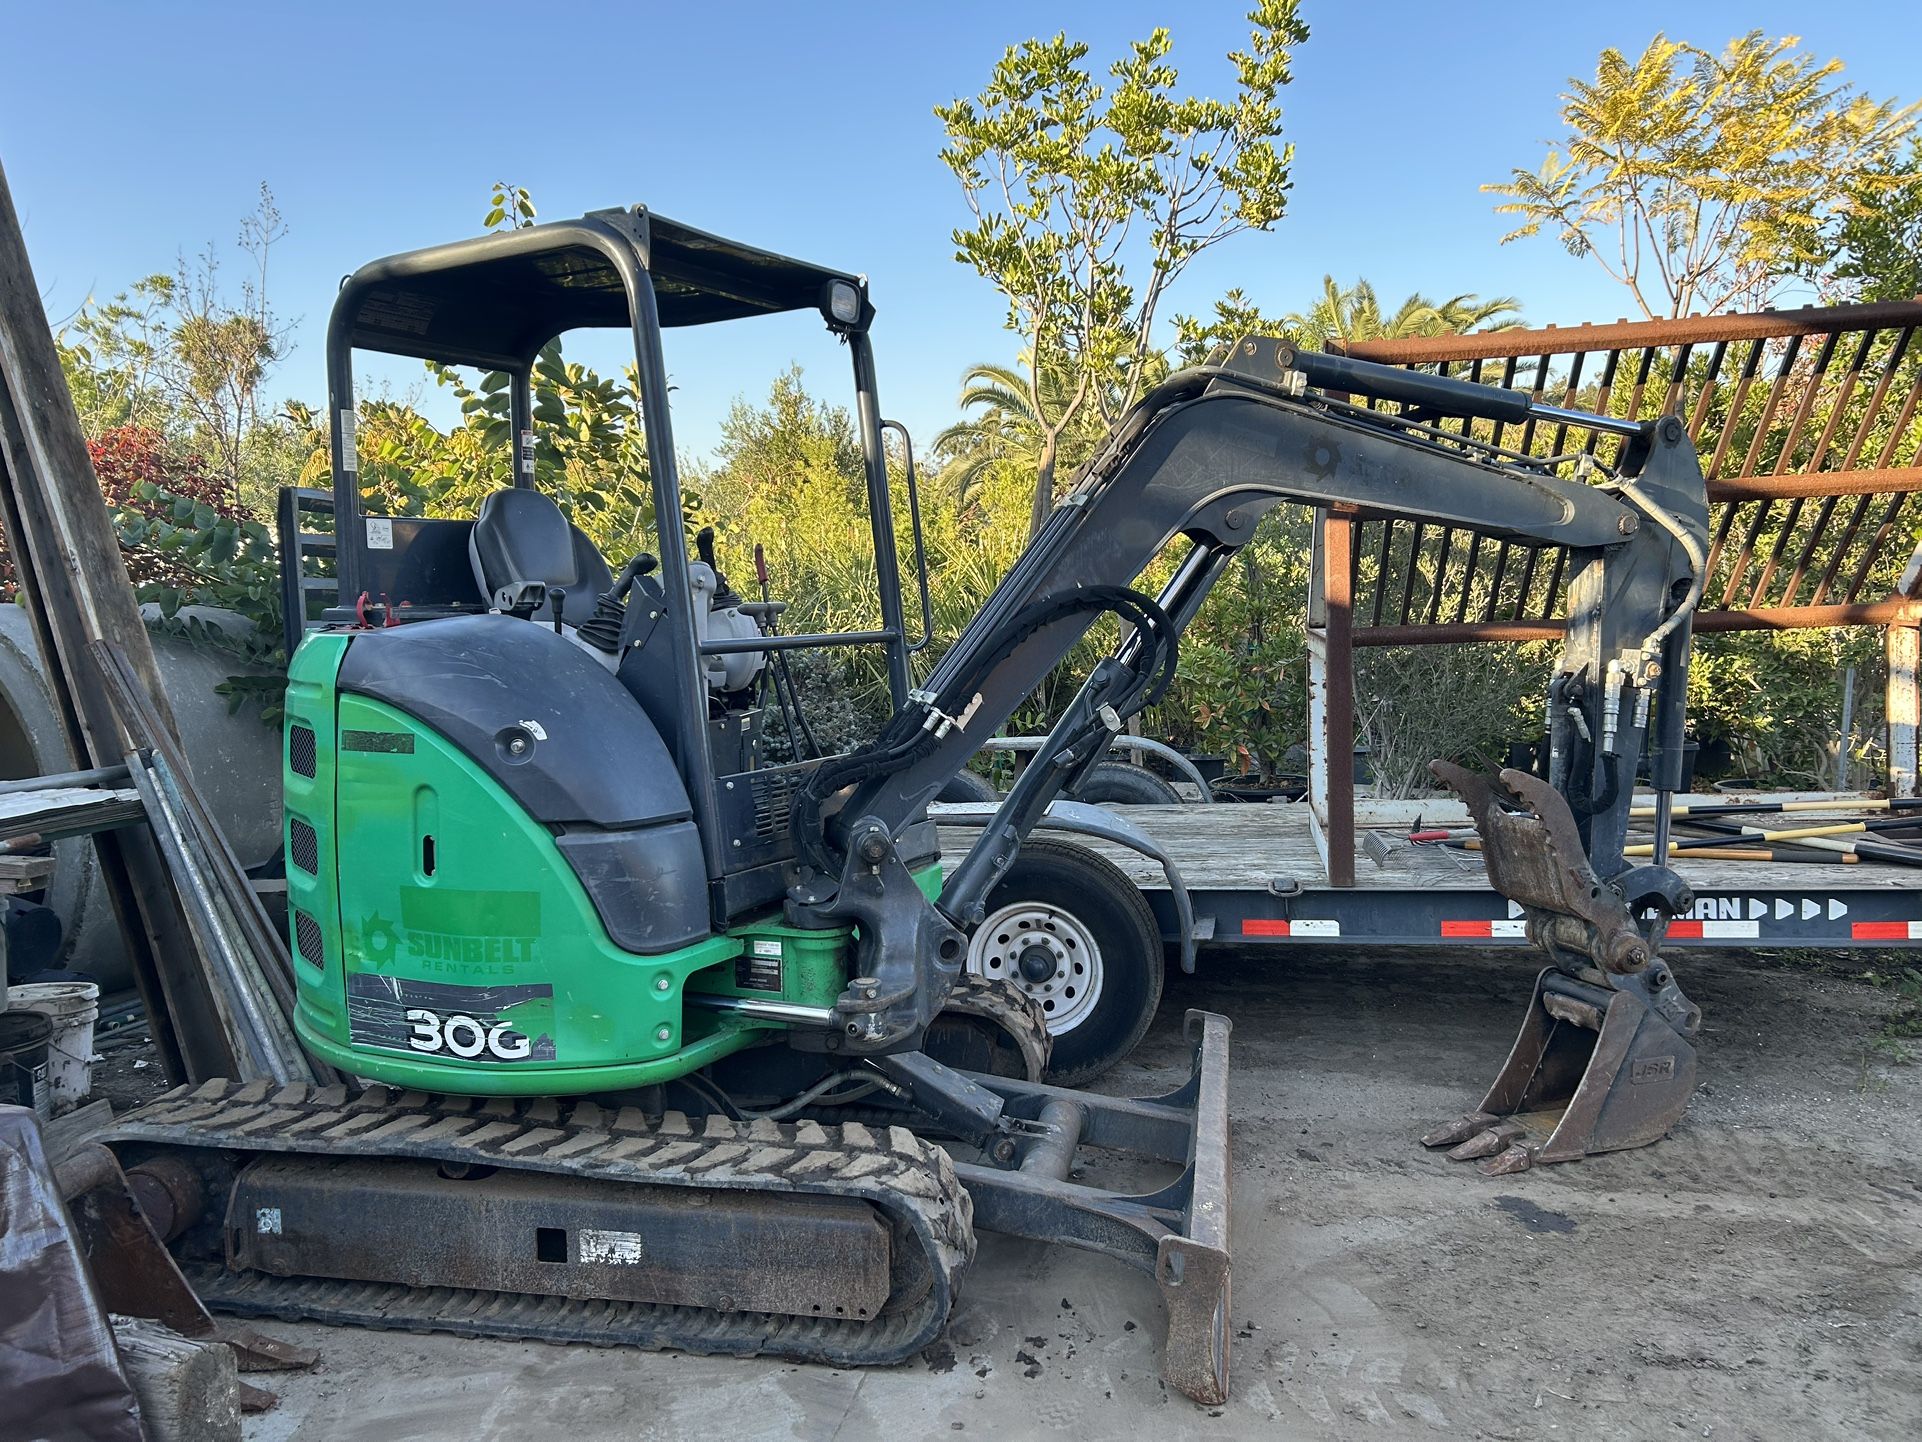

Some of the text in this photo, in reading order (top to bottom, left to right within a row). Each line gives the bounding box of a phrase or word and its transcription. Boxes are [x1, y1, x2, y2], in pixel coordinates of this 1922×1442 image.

[407, 931, 537, 963] SUNBELT
[422, 960, 515, 975] RENTALS
[406, 1009, 530, 1059] 30G
